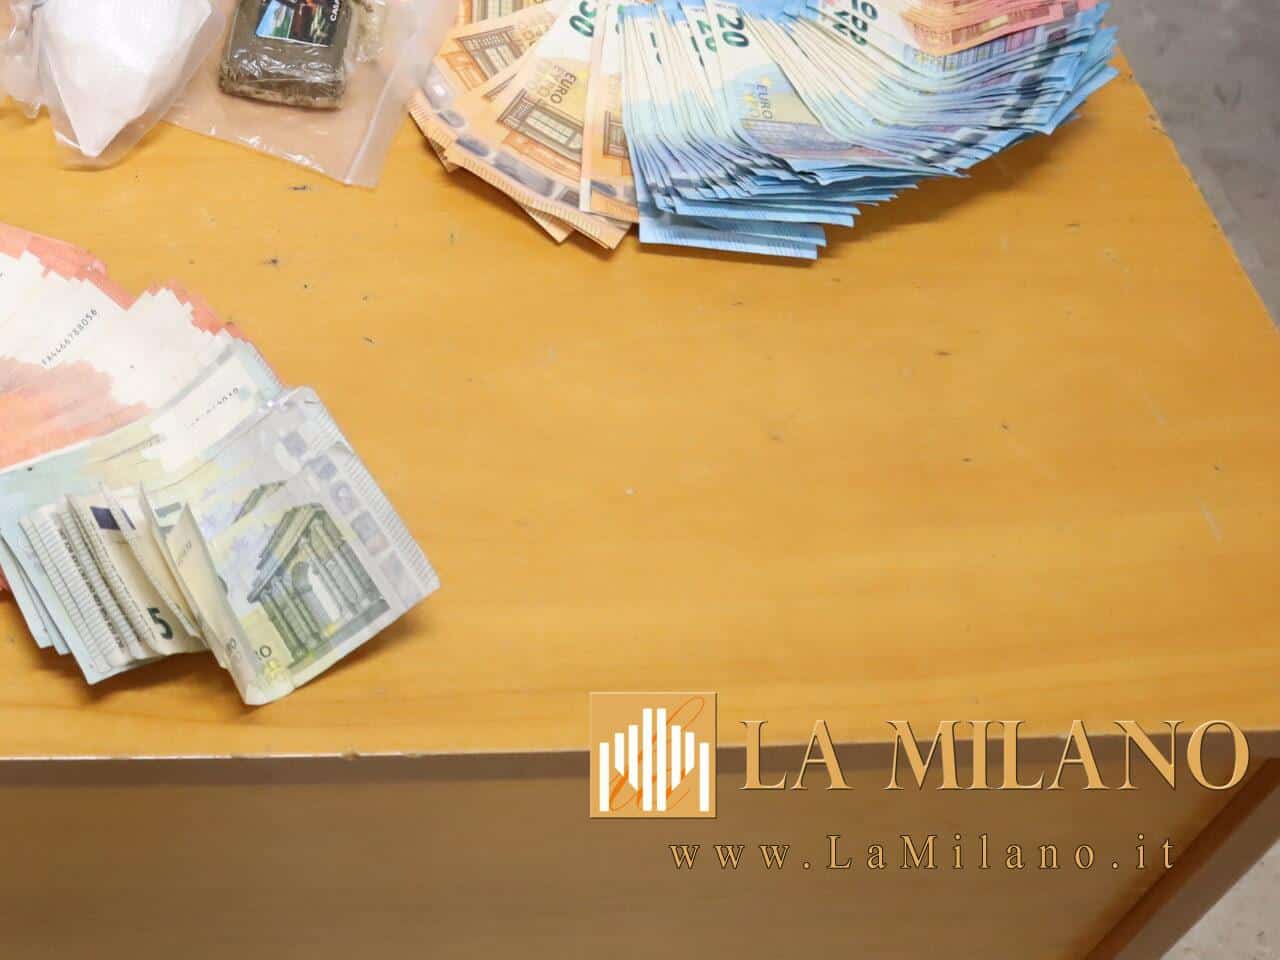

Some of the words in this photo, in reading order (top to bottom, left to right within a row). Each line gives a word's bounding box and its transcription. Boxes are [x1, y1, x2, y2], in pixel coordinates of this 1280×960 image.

[716, 13, 750, 48] 20
[550, 72, 577, 105] EURO
[756, 83, 774, 120] EURO
[147, 607, 174, 640] 5
